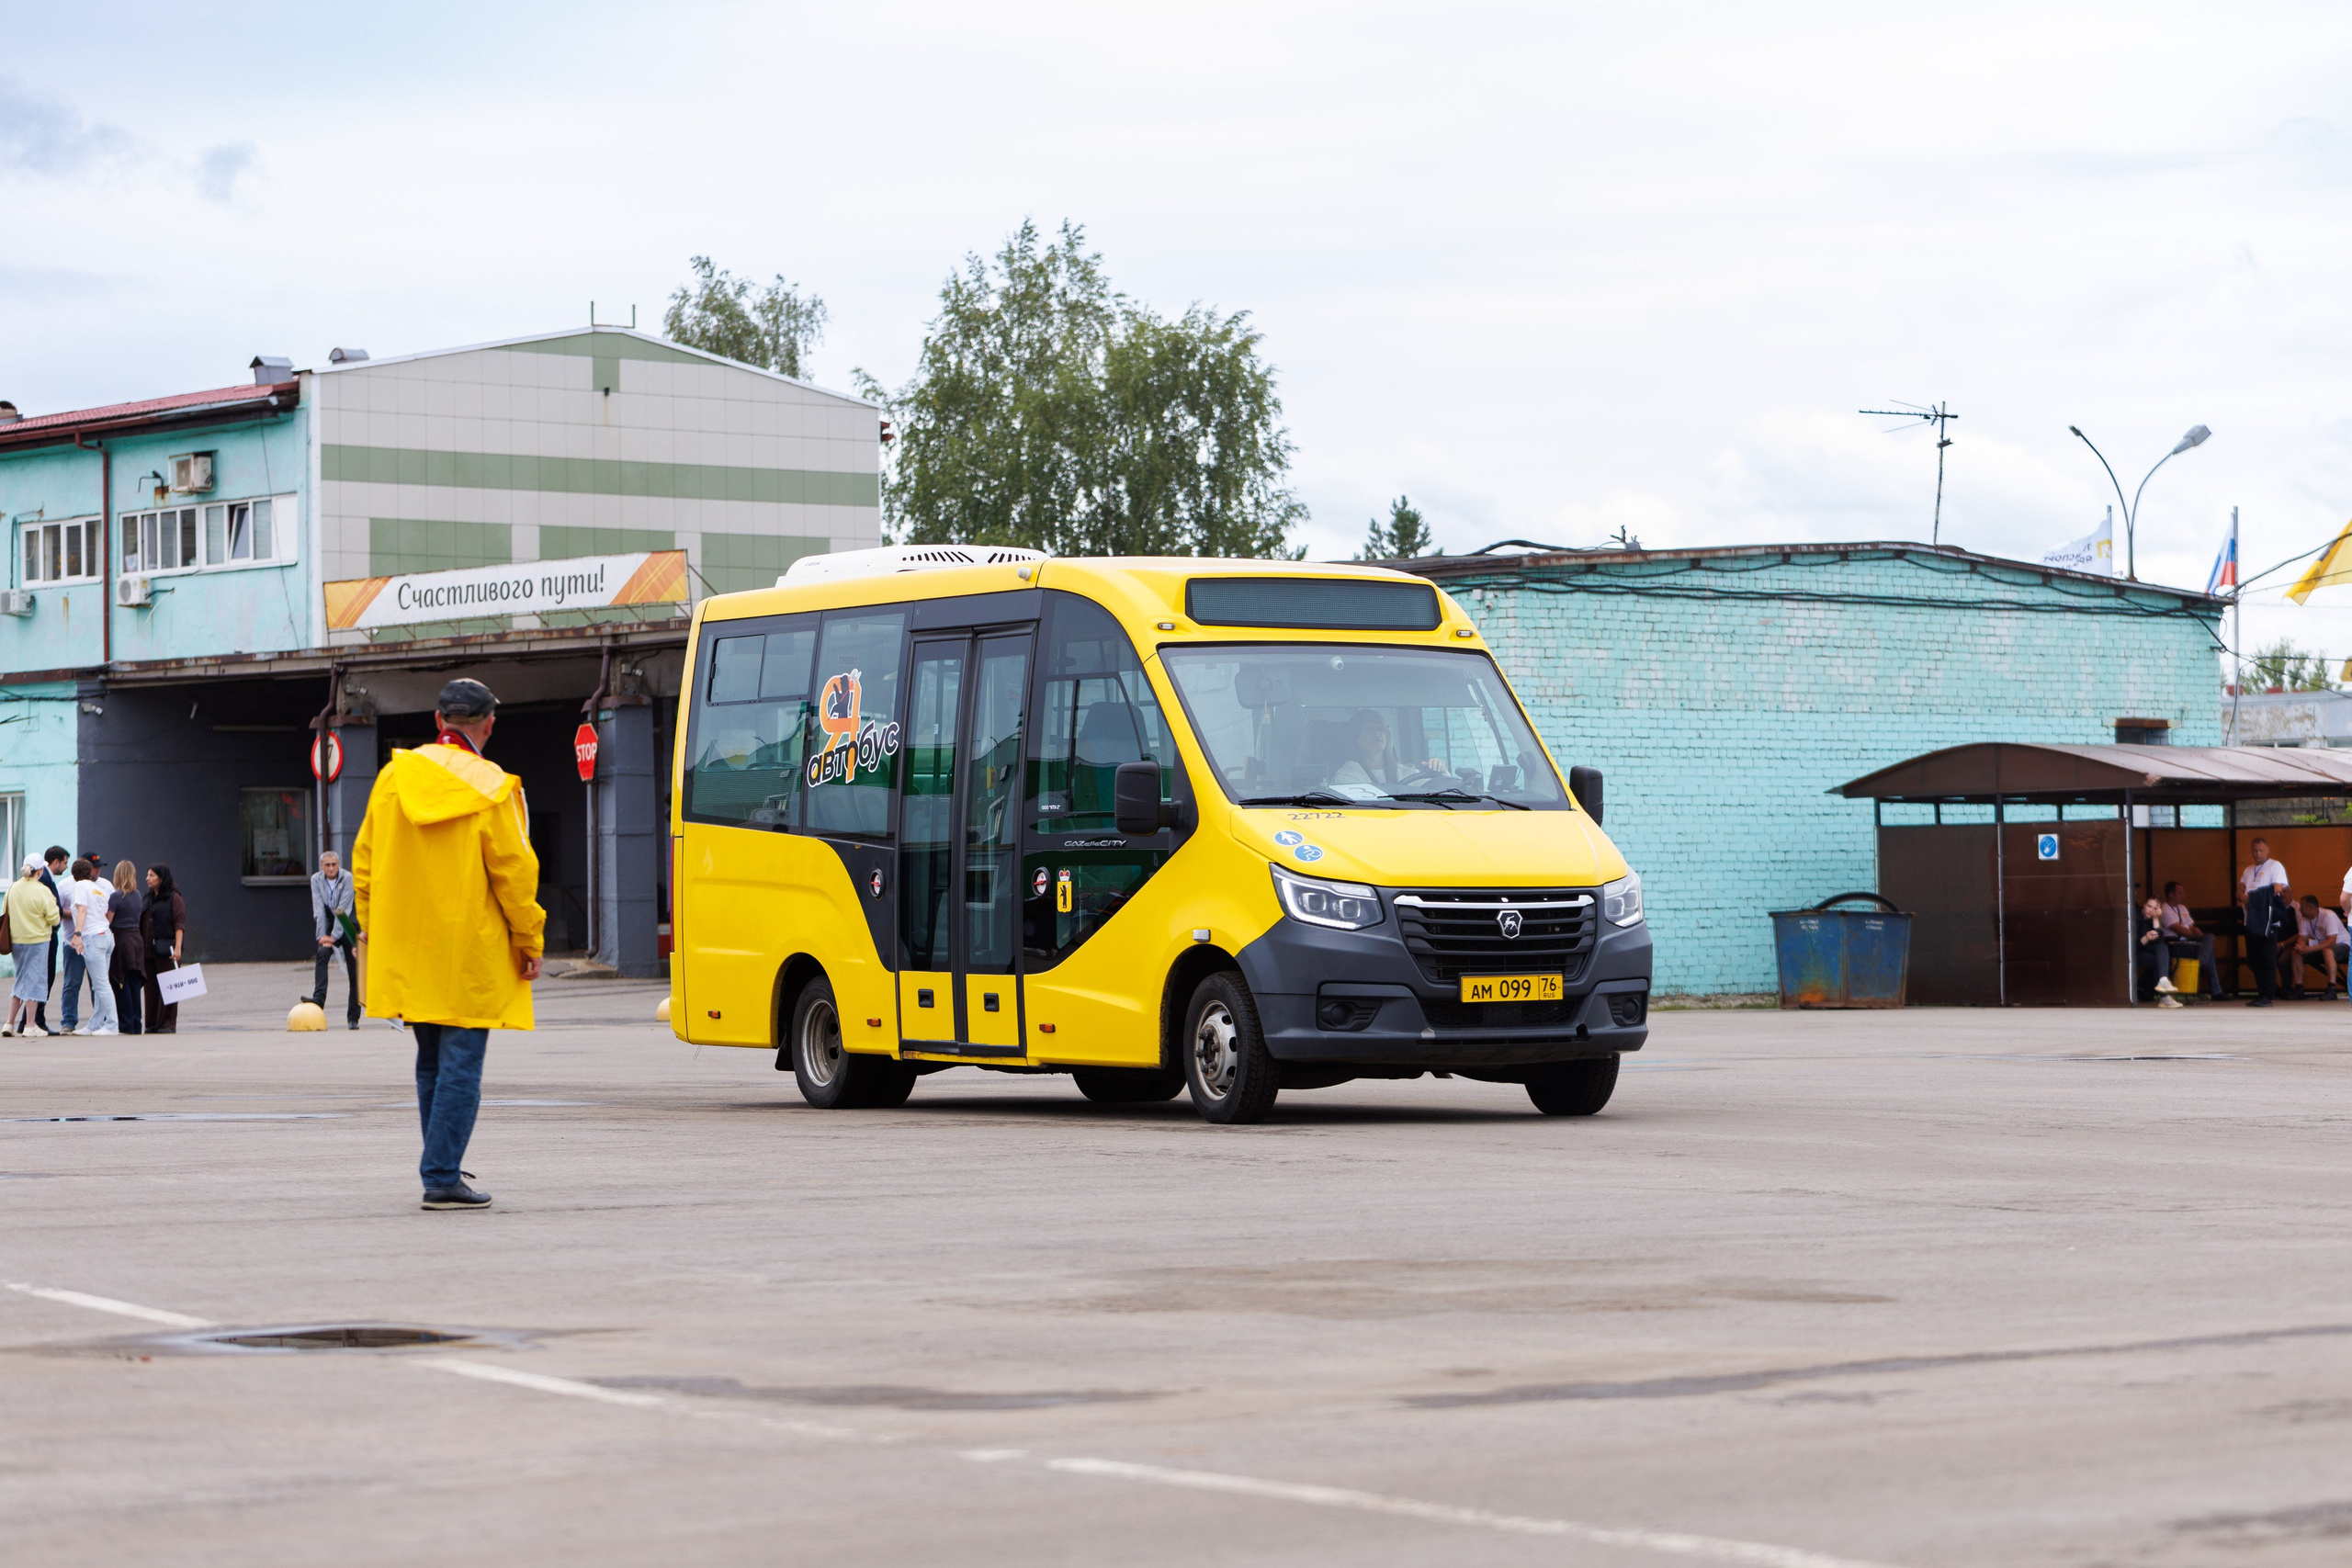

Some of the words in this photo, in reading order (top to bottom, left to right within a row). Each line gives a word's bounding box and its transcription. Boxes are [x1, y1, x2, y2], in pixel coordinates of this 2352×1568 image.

[398, 581, 533, 610] Счастливого
[541, 563, 605, 605] пути!
[576, 742, 597, 762] STOP
[1349, 787, 1376, 797] 3
[1287, 811, 1346, 820] 22722
[1499, 979, 1532, 998] 099
[1541, 977, 1557, 992] 76
